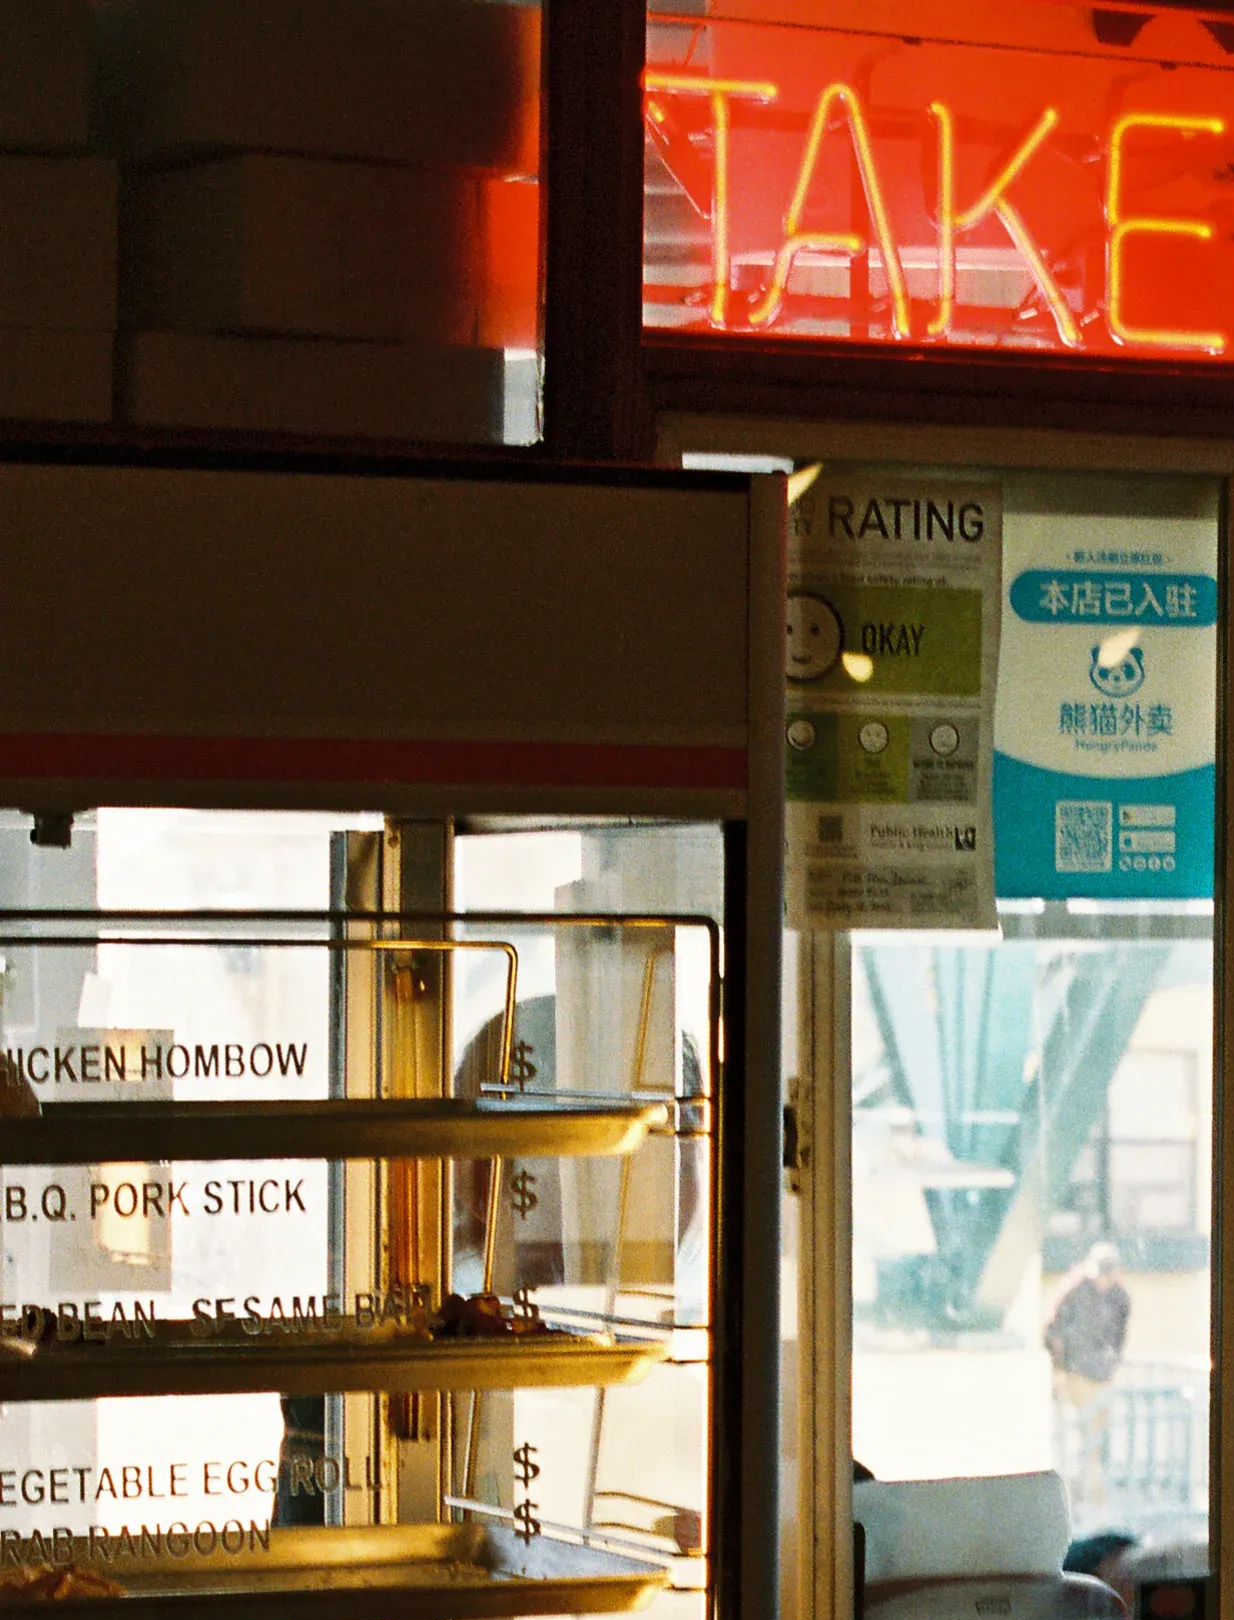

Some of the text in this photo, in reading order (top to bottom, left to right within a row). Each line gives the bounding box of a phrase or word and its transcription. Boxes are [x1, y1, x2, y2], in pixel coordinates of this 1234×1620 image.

[644, 68, 1228, 354] TAKE
[827, 499, 985, 543] RATING
[1038, 578, 1198, 619] 本店已入驻
[861, 624, 927, 658] OKAY
[1057, 701, 1174, 737] 熊猫外卖
[141, 1042, 308, 1079] HOMBOW
[510, 1041, 537, 1092] $
[90, 1181, 189, 1217] PORK
[203, 1178, 307, 1214] STICK
[510, 1170, 538, 1219] $
[55, 1300, 156, 1341] BEAN
[203, 1460, 279, 1496] EGG
[288, 1457, 383, 1497] ROLL
[512, 1442, 540, 1489] $
[87, 1519, 272, 1563] RANGOON
[513, 1499, 541, 1546] $
